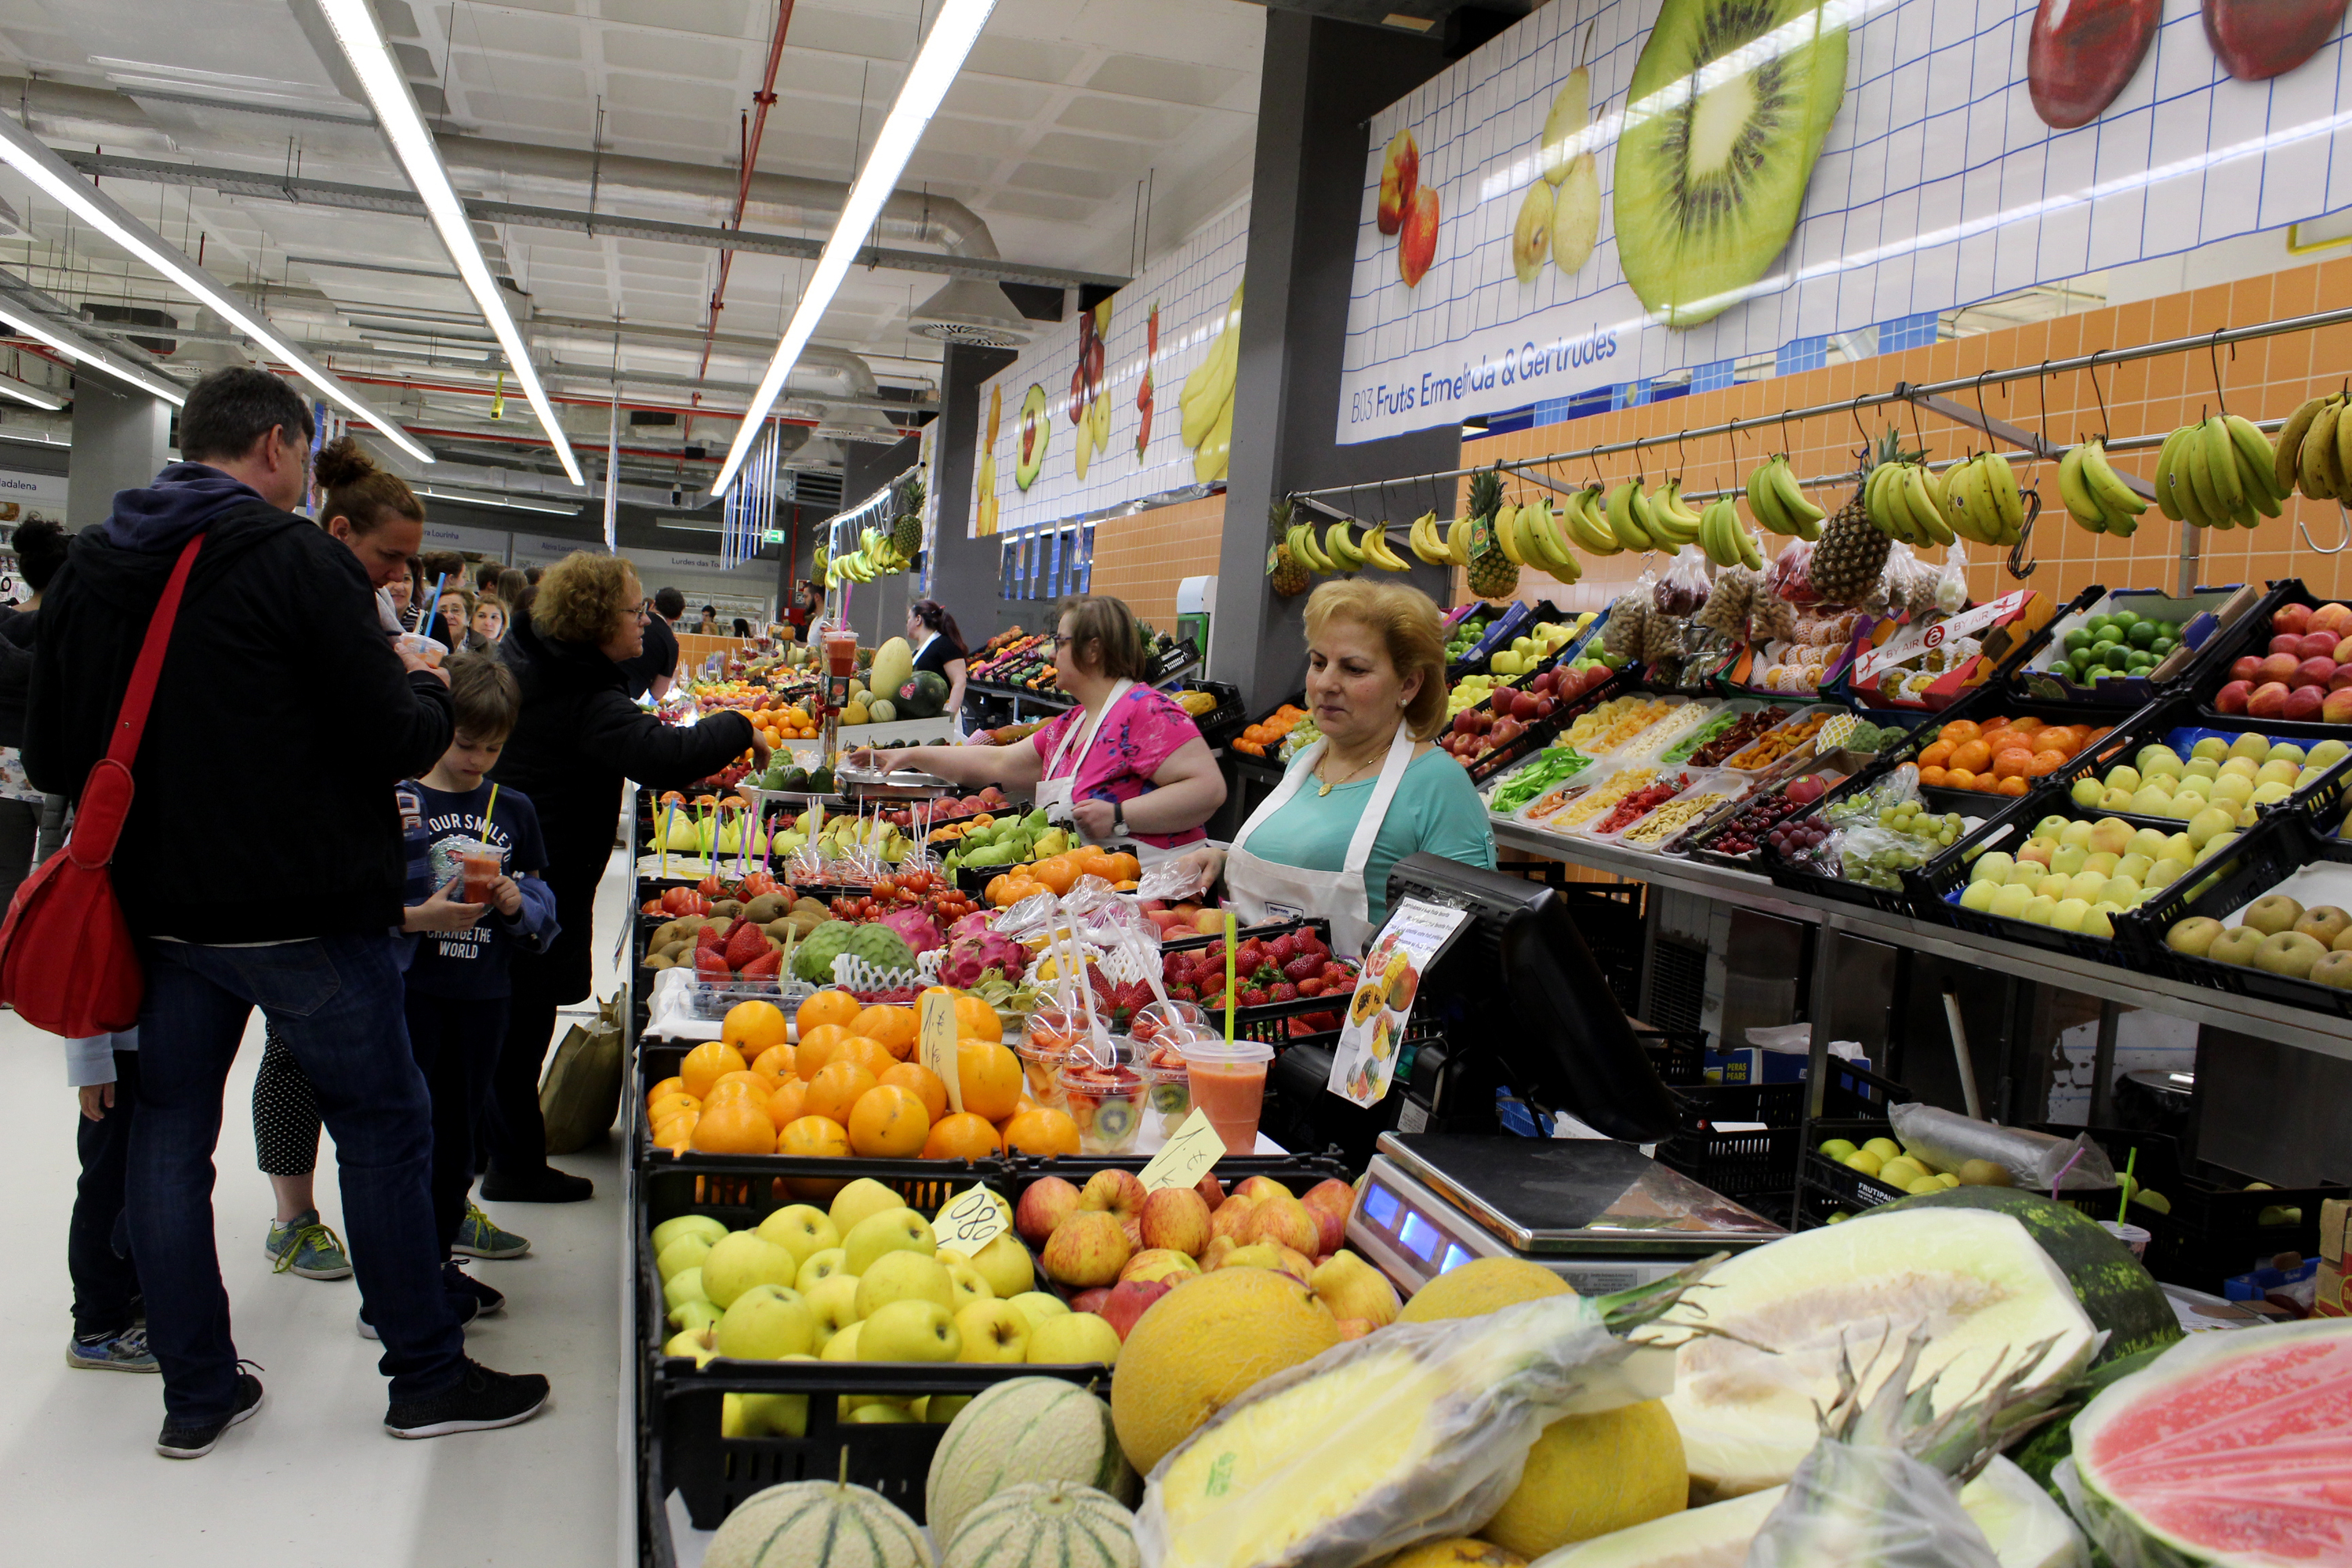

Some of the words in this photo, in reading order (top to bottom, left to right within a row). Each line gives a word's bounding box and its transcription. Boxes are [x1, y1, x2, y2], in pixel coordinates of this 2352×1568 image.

[1352, 388, 1373, 423] B03
[1501, 348, 1515, 385] &
[1519, 322, 1617, 380] Gertrudes
[0, 477, 37, 491] adalena
[672, 557, 695, 566] Lurdes
[1886, 647, 1900, 659] BY
[1902, 638, 1919, 652] AIR
[1954, 619, 1968, 632] BY
[1970, 611, 1989, 625] AIR
[429, 813, 461, 835] OUR
[464, 814, 509, 847] SMILE
[474, 927, 492, 942] THE
[439, 941, 478, 959] WORLD
[1726, 1072, 1746, 1080] PEARS
[951, 1193, 997, 1240] 0.80
